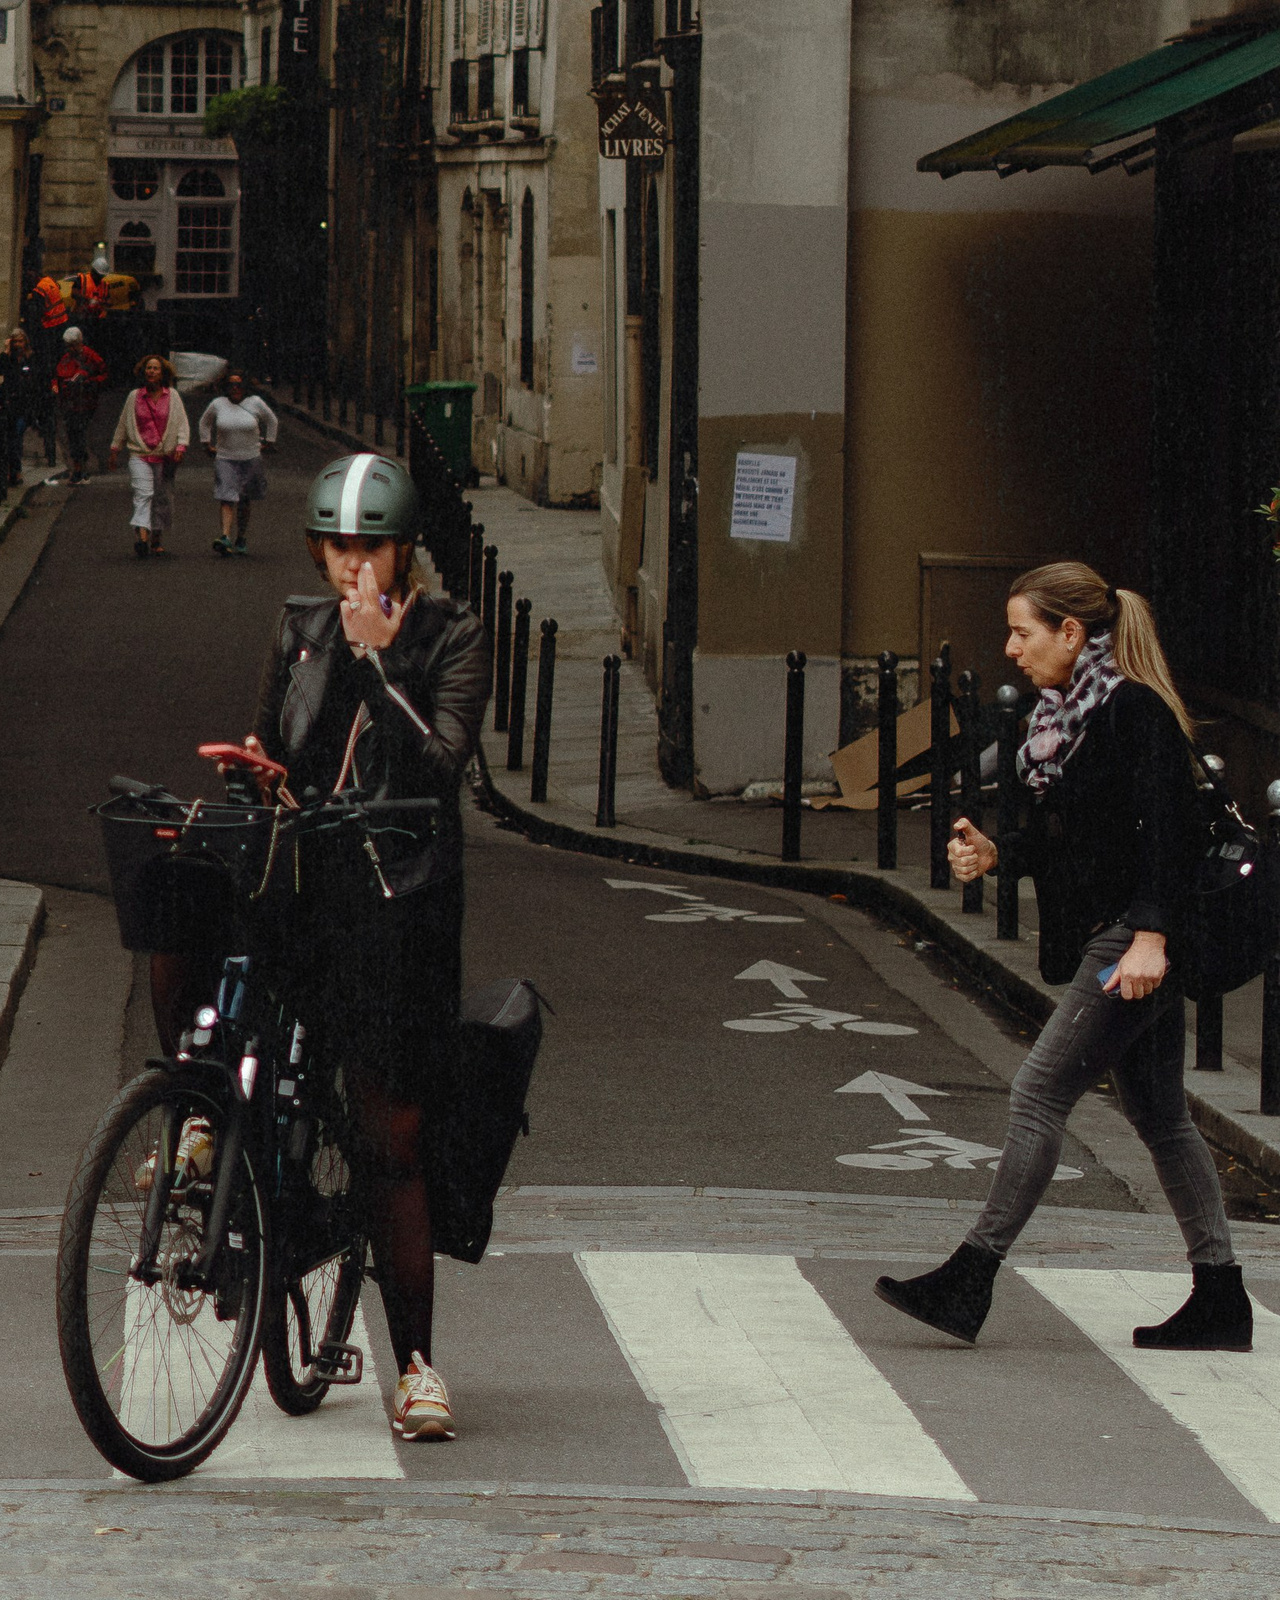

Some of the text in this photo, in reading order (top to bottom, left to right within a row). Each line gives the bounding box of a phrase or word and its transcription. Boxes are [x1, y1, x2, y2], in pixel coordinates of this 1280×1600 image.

[601, 102, 631, 137] ACHAT
[634, 102, 666, 136] VENTE
[605, 138, 664, 157] LIVRES
